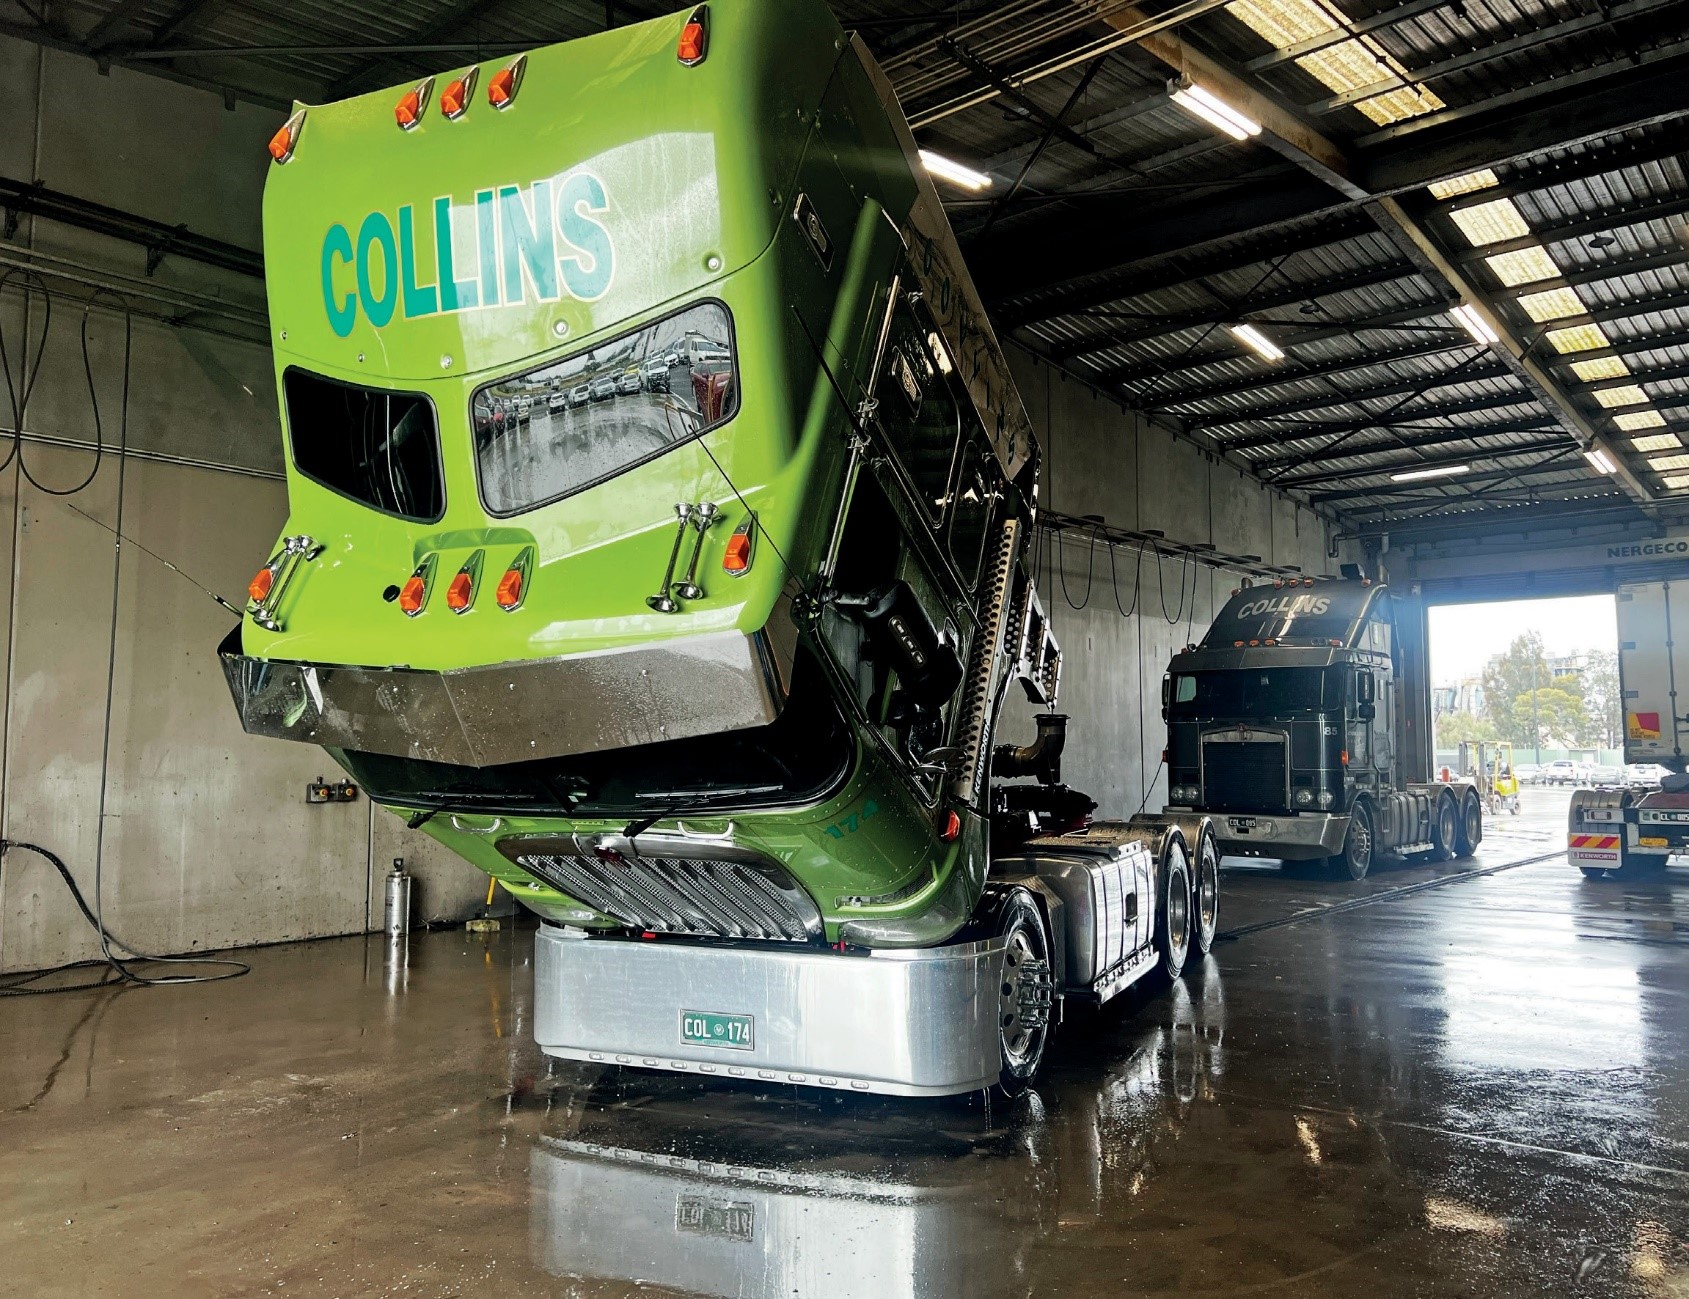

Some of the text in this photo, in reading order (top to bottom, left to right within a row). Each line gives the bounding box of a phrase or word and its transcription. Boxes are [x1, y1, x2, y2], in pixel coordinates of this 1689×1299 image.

[321, 171, 617, 338] COLLINS
[1607, 541, 1688, 558] NERGECO
[1237, 594, 1330, 619] COLLINS
[1324, 727, 1337, 735] 85
[1580, 852, 1617, 861] KENWORTH
[684, 1018, 750, 1042] COL 174
